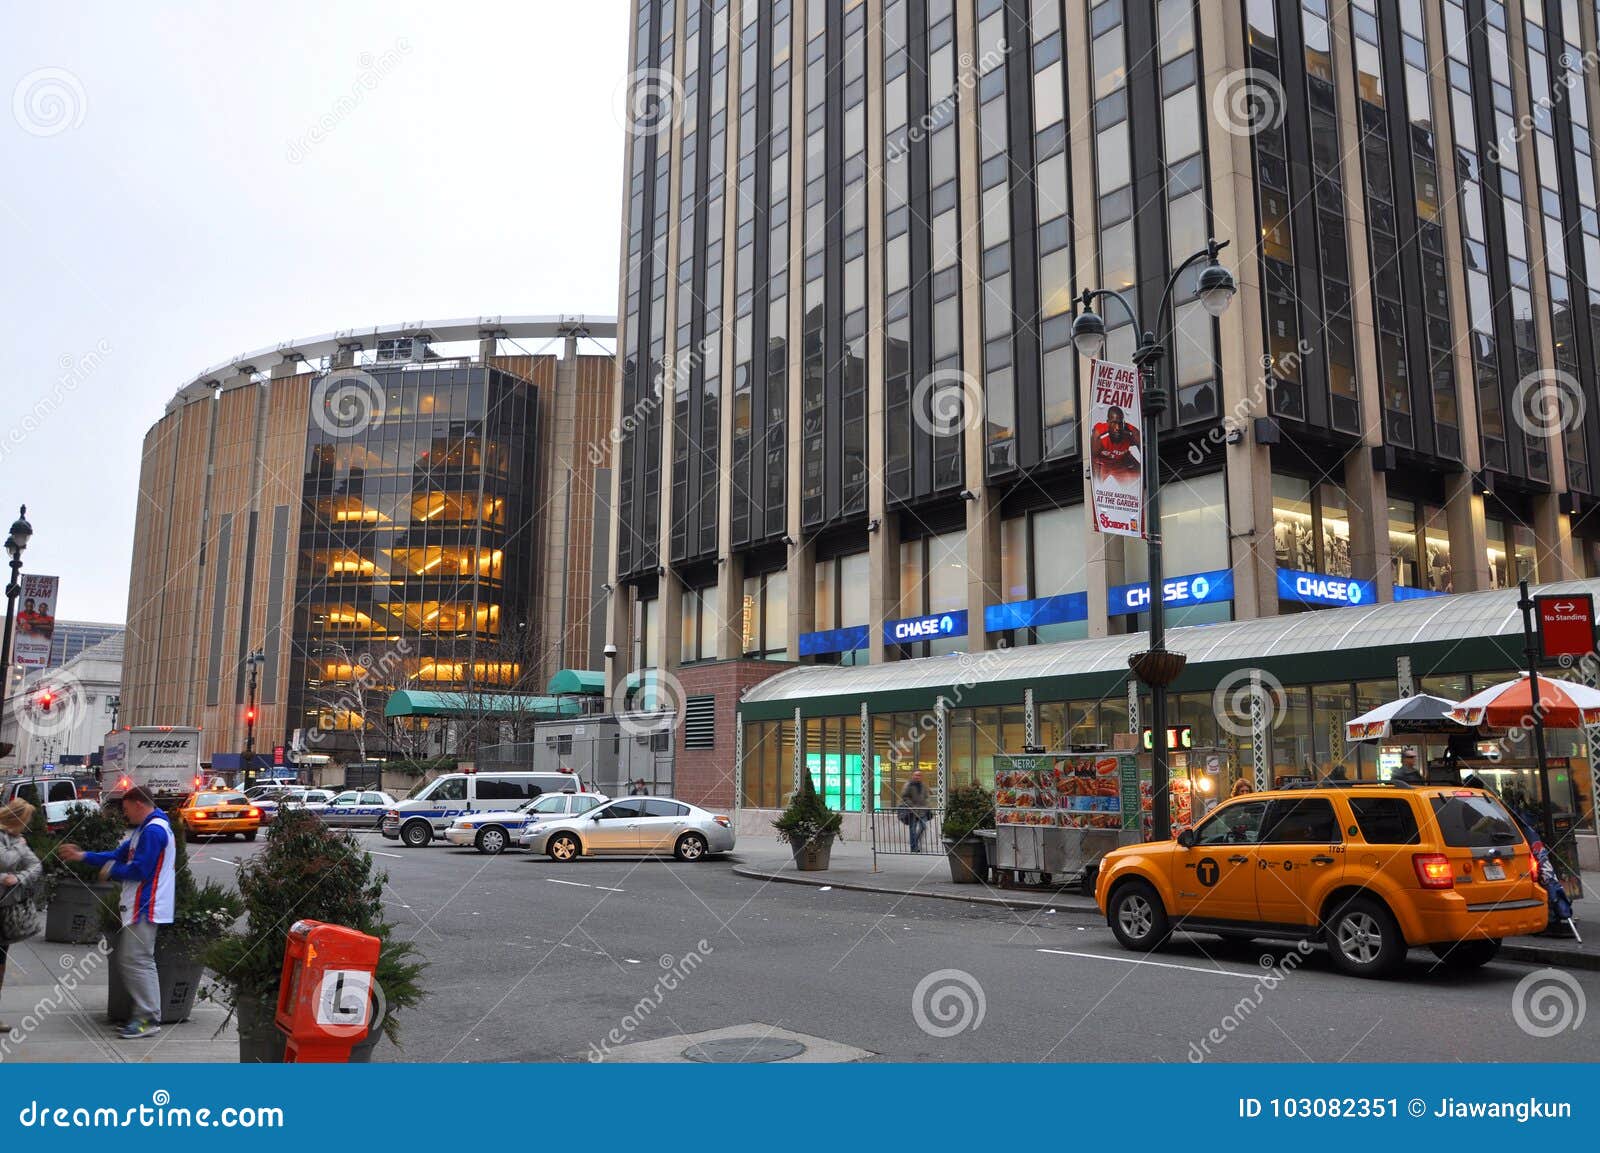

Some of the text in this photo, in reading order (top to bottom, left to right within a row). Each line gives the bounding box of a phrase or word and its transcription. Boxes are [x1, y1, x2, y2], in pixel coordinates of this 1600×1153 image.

[1097, 379, 1112, 387] NEW
[1098, 365, 1134, 383] WE ARE
[1096, 387, 1133, 408] TEAM
[1117, 499, 1139, 508] GARDEN
[24, 588, 52, 598] TEAM
[1126, 581, 1189, 606] CHSE
[1296, 577, 1348, 600] CHASE
[1555, 614, 1587, 622] Standing
[895, 618, 939, 638] CHASE
[137, 740, 190, 748] PENSKE
[1012, 758, 1036, 769] METRO
[1202, 863, 1214, 883] T
[333, 973, 358, 1014] L
